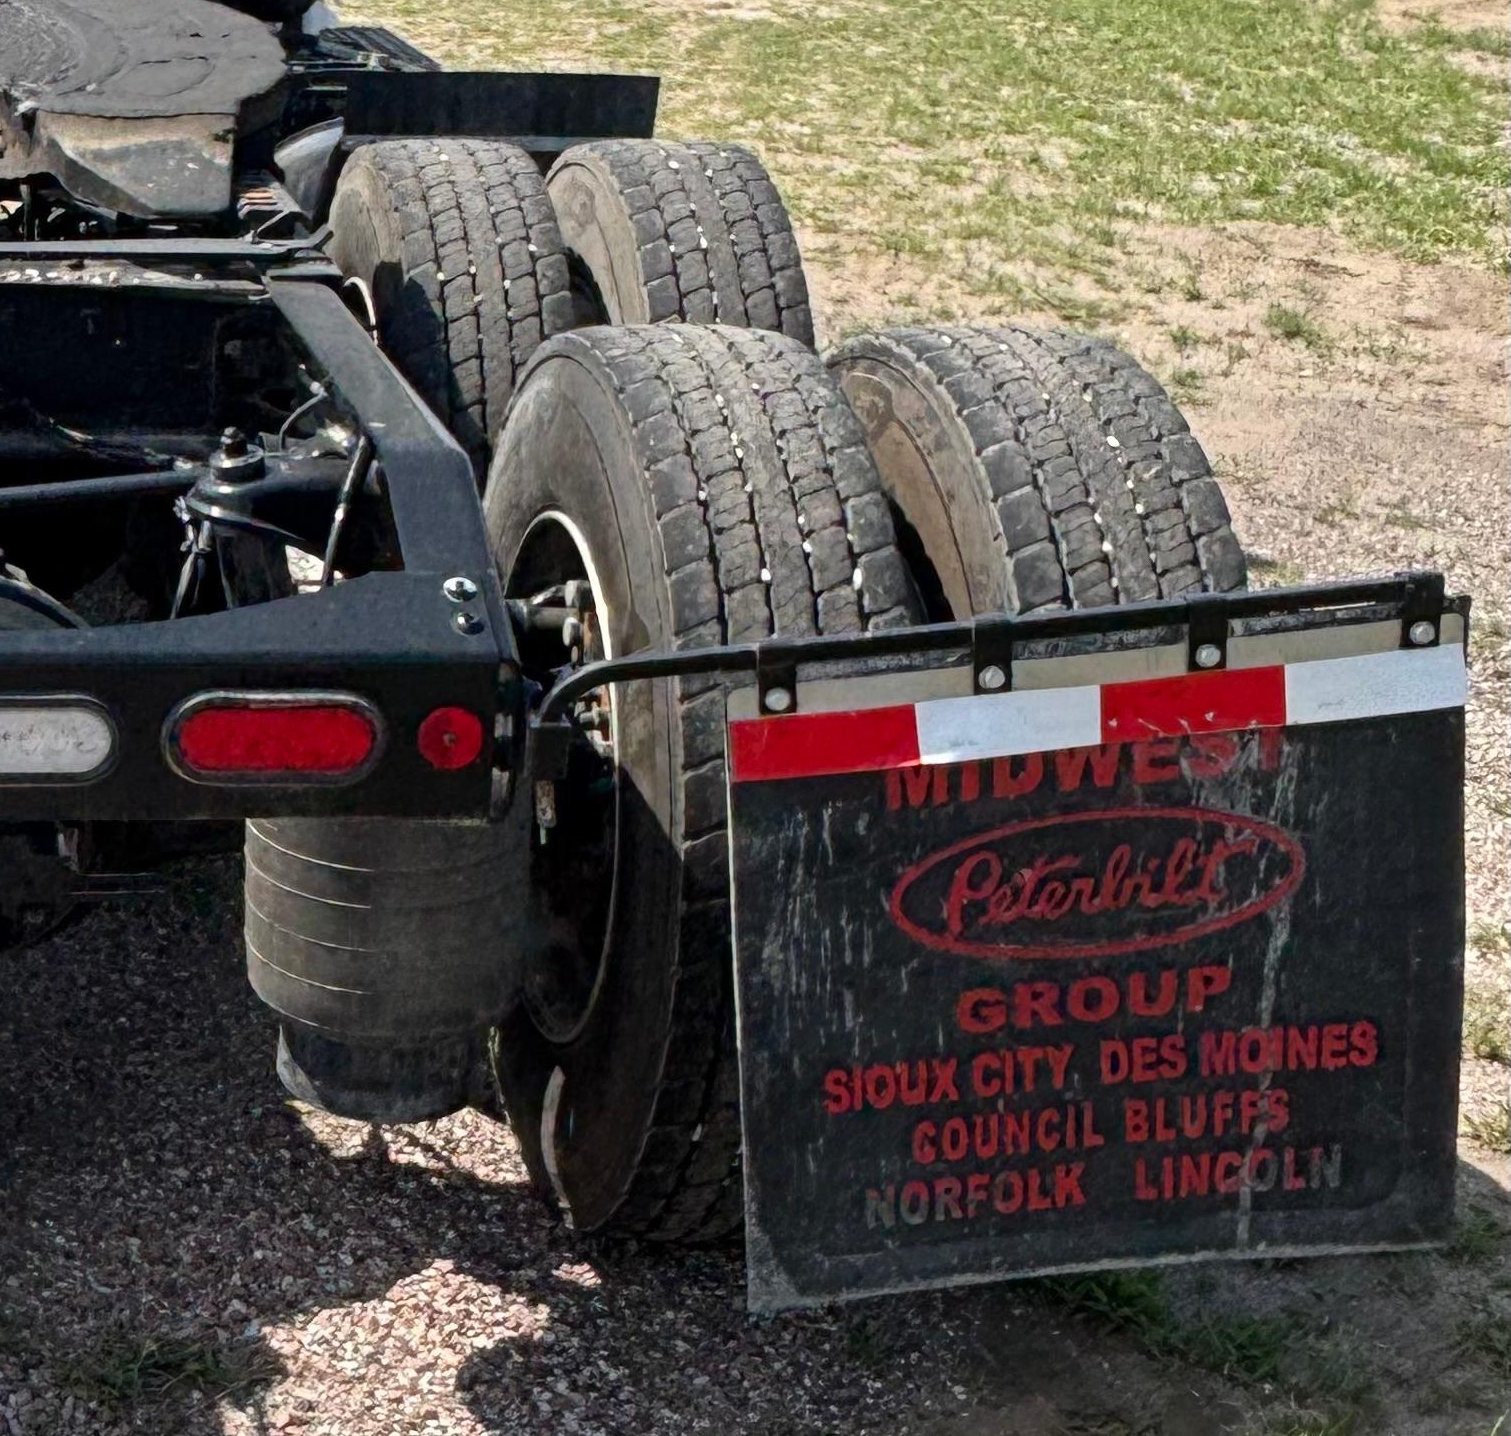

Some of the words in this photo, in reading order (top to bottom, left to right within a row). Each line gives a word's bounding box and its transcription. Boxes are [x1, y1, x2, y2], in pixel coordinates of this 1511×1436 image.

[947, 836, 1259, 941] Peterbilt
[956, 965, 1232, 1034] GROUP
[823, 1058, 959, 1115] SIOUX
[972, 1044, 1073, 1098] CITY
[1100, 1034, 1188, 1085] DES
[1200, 1020, 1378, 1077] MOINES
[912, 1102, 1105, 1164] COUNCIL
[1124, 1088, 1290, 1143] BLUFFS
[865, 1162, 1086, 1228] NORFOLK
[1134, 1143, 1342, 1201] LINCOLN
